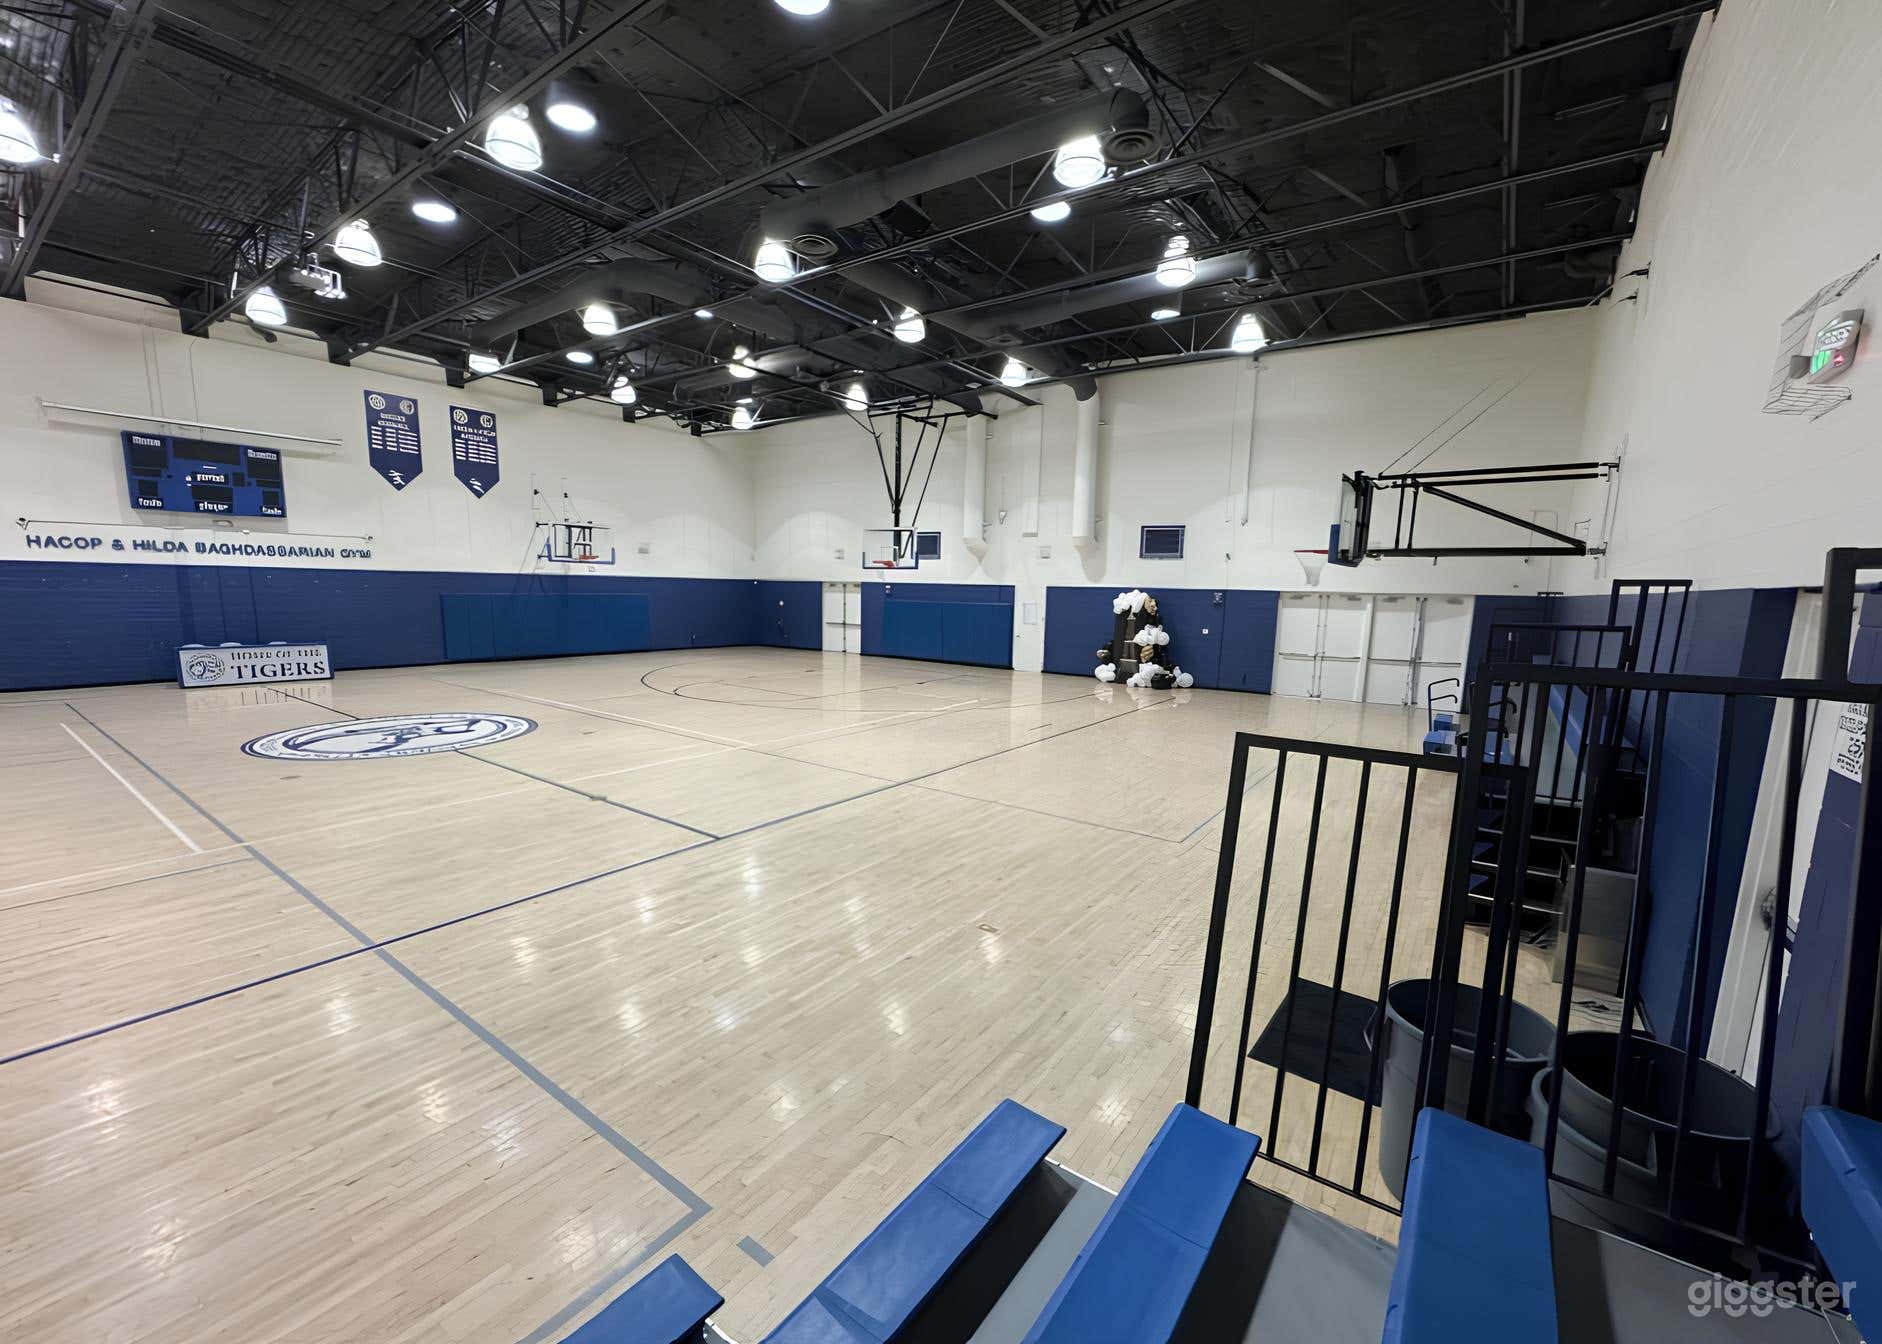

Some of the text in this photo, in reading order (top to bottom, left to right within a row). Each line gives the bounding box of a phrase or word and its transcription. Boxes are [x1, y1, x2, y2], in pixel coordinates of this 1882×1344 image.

[25, 534, 103, 550] HACOP
[111, 538, 125, 551] &
[132, 539, 189, 553] HILDA
[231, 660, 326, 680] TIGERS
